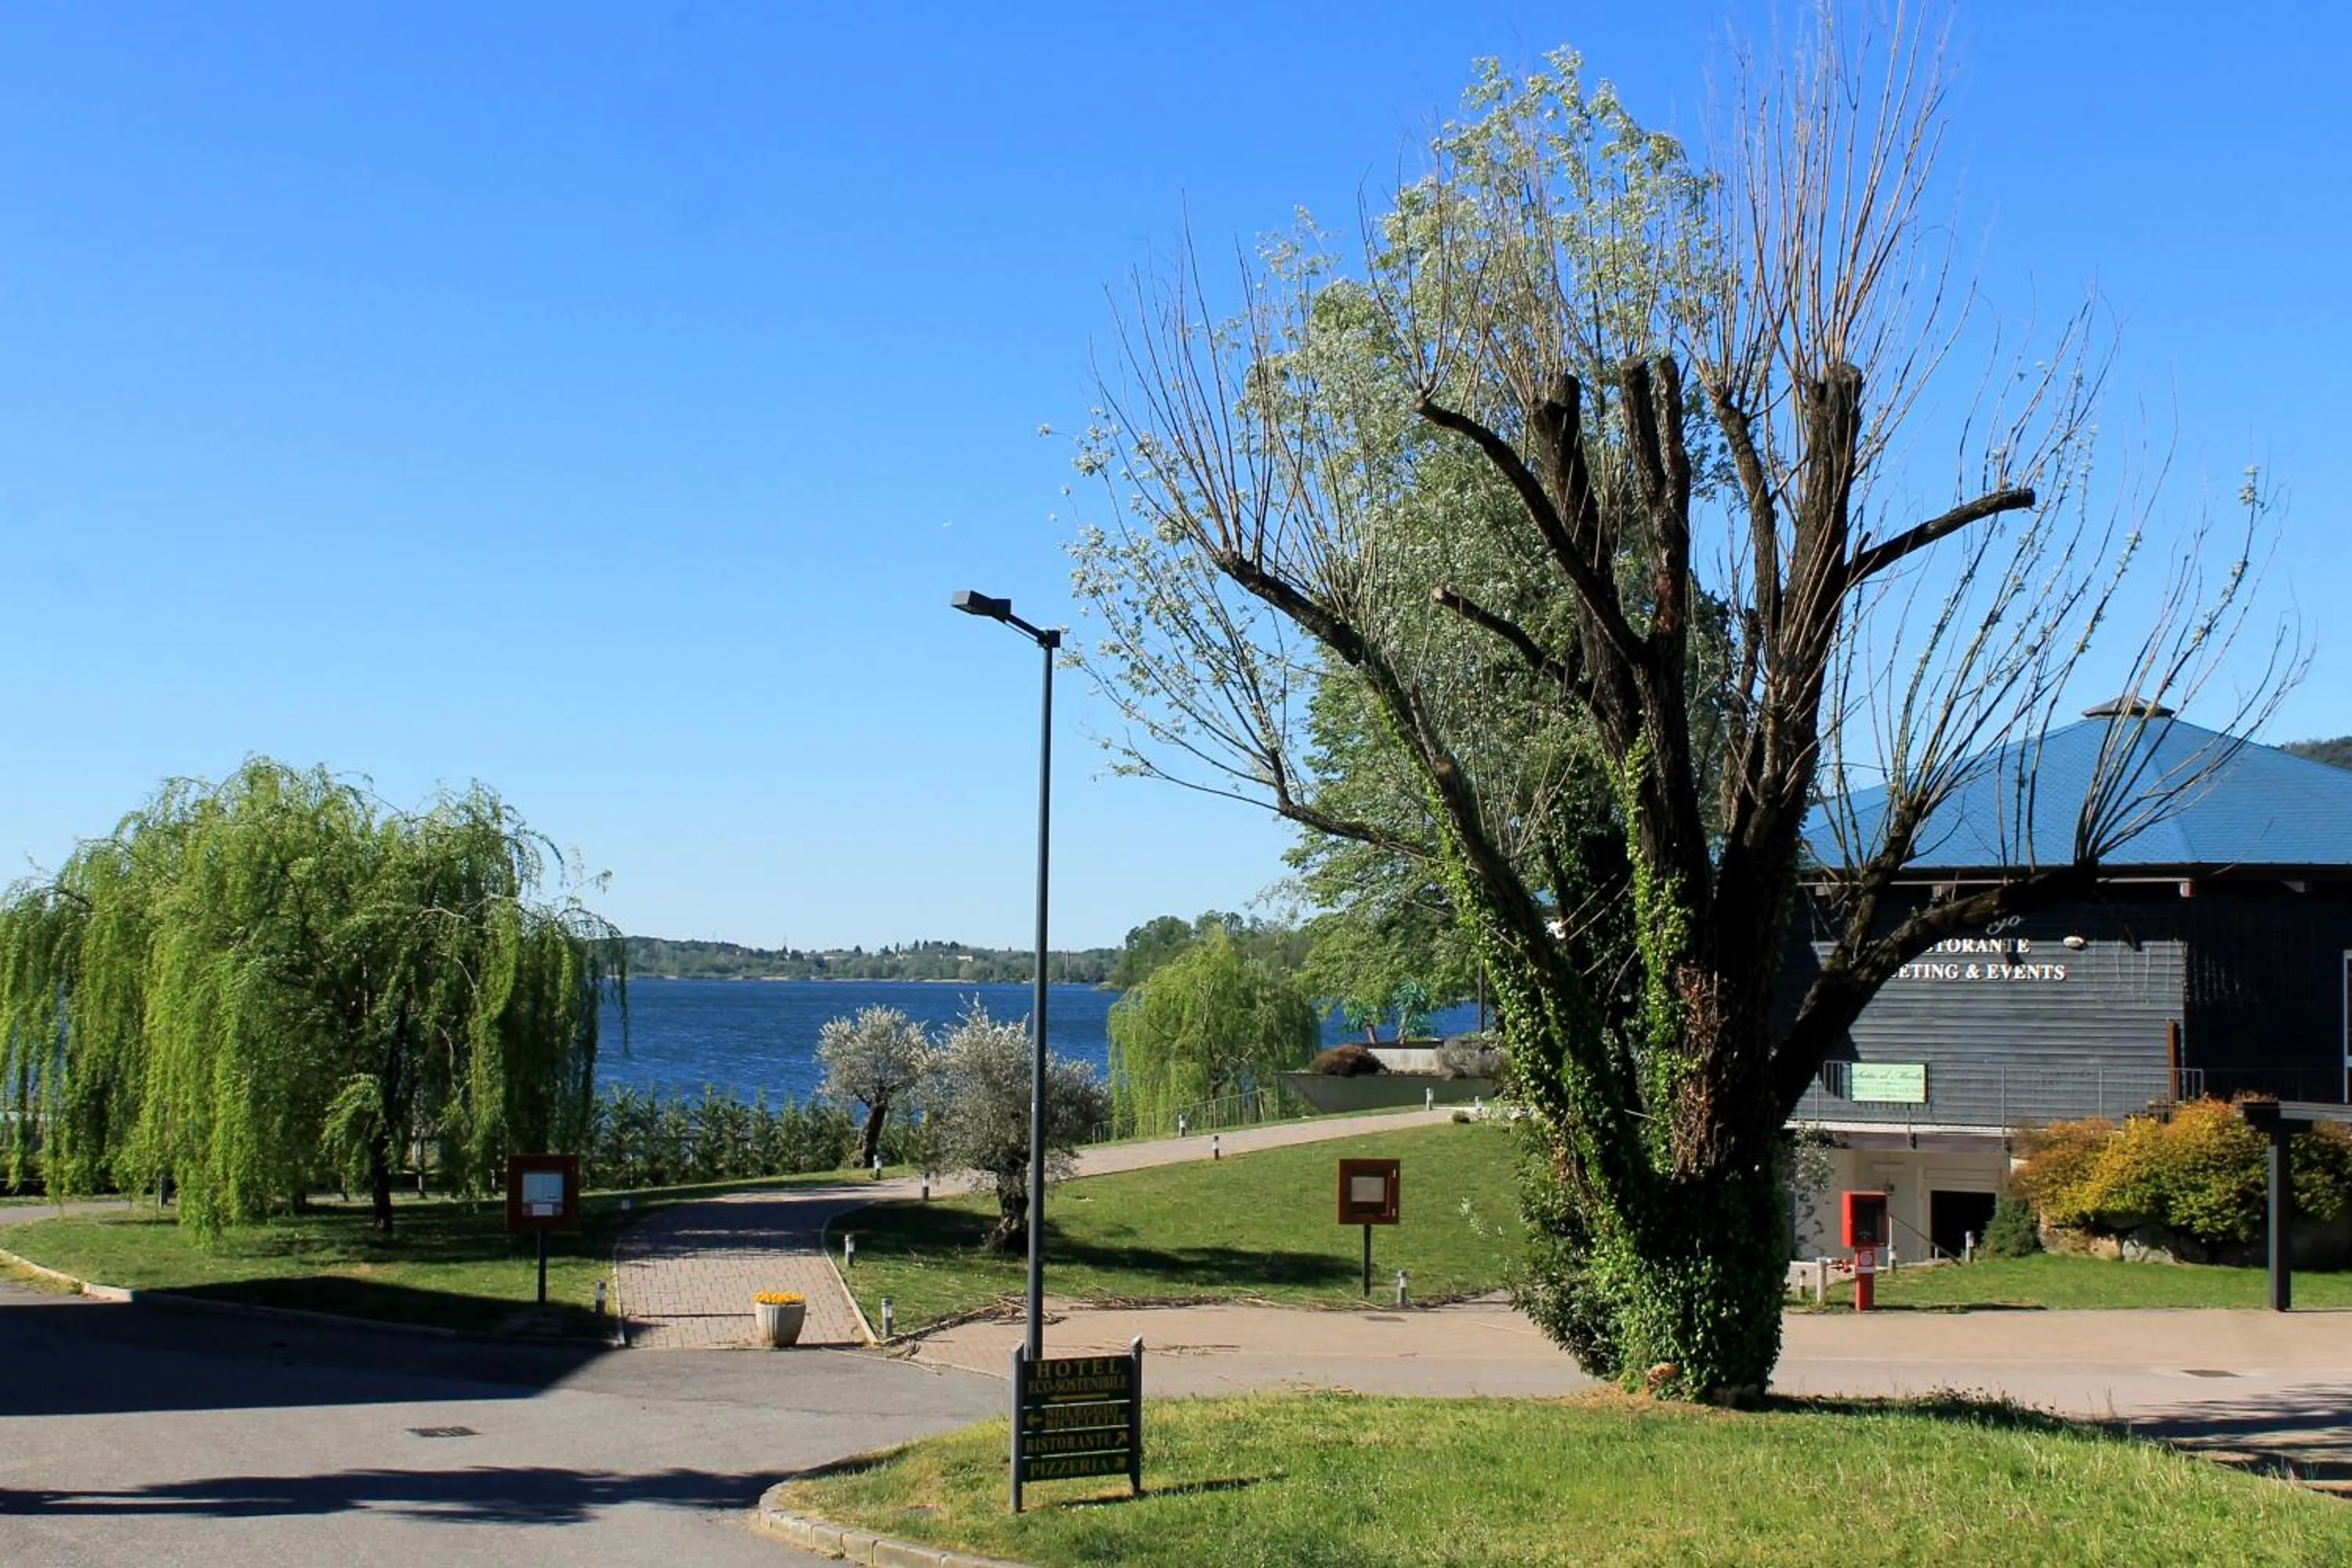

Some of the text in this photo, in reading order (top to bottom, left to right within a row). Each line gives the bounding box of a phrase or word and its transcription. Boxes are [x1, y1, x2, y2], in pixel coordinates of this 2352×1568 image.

[1925, 938, 2031, 953] TORANTE
[1890, 964, 2067, 980] ETING & EVENTS
[1036, 1359, 1120, 1377] HOTEL
[1026, 1434, 1111, 1452] RISTORANTE
[1030, 1458, 1109, 1476] PIZZERIA
